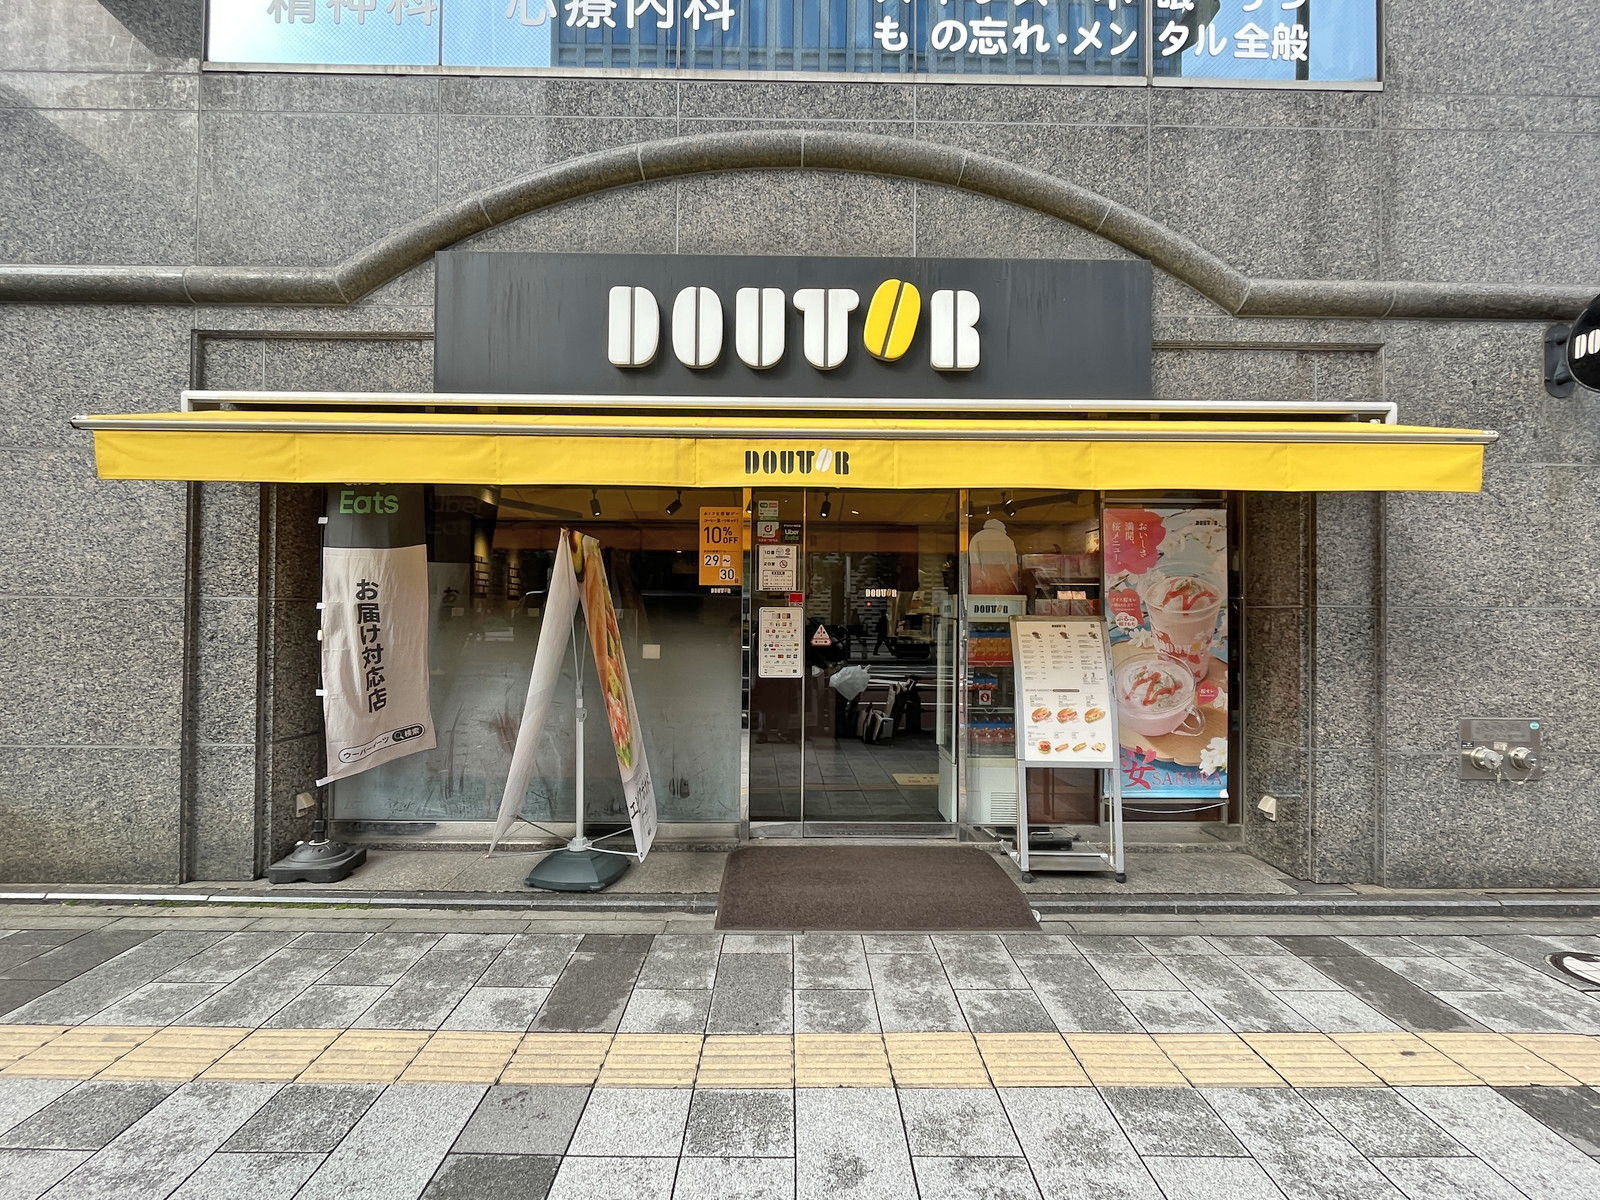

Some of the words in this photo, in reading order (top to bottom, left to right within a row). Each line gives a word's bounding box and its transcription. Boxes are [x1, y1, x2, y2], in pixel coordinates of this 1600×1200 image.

[608, 278, 981, 372] DOUTOR
[744, 447, 850, 476] DOUTOR
[339, 490, 399, 514] Eats
[722, 536, 739, 544] OFF
[1138, 522, 1148, 558] おいしさ
[865, 588, 897, 598] DOUTOR
[355, 578, 388, 713] お届け対応店
[343, 736, 390, 760] ウーバーイーツ
[1152, 770, 1223, 786] SAKURA
